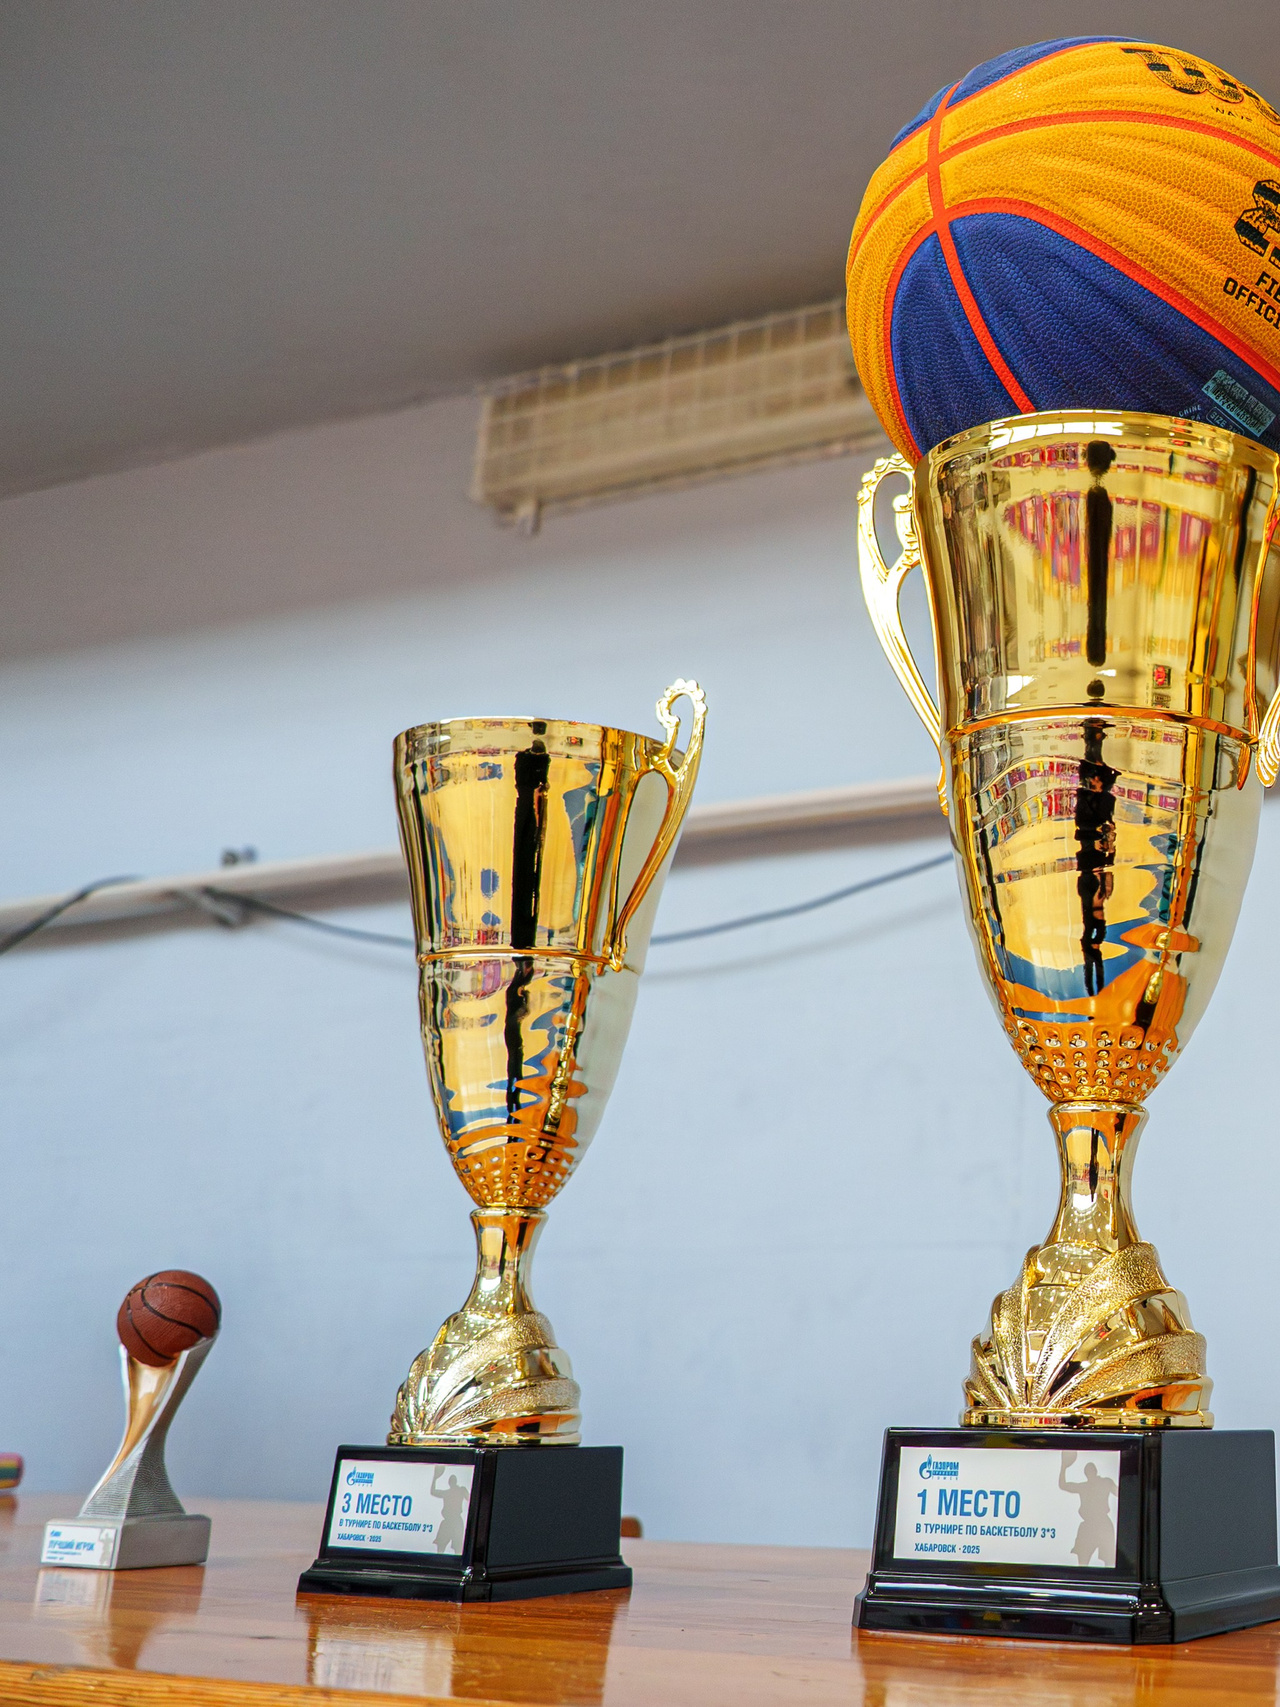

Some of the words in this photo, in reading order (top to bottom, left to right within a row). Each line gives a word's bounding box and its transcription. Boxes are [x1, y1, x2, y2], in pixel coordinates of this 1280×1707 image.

[1210, 411, 1228, 428] SIZE
[342, 1492, 352, 1513] 3
[355, 1493, 413, 1517] МЕСТО
[917, 1488, 927, 1515] 1
[937, 1488, 1021, 1518] МЕСТО
[339, 1518, 343, 1527] В
[345, 1518, 371, 1530] ТУРНИРЕ
[372, 1521, 381, 1530] ПО
[382, 1522, 421, 1532] БАСКЕТБОЛУ
[915, 1522, 922, 1533] В
[924, 1522, 963, 1535] ТУРНИРЕ
[965, 1524, 978, 1535] ПО
[979, 1525, 1038, 1538] БАСКЕТБОЛУ
[337, 1533, 366, 1541] ХАБАРОВСК
[369, 1535, 382, 1543] 2025
[914, 1542, 956, 1553] ХАБАРОВСК
[962, 1545, 980, 1554] 2025
